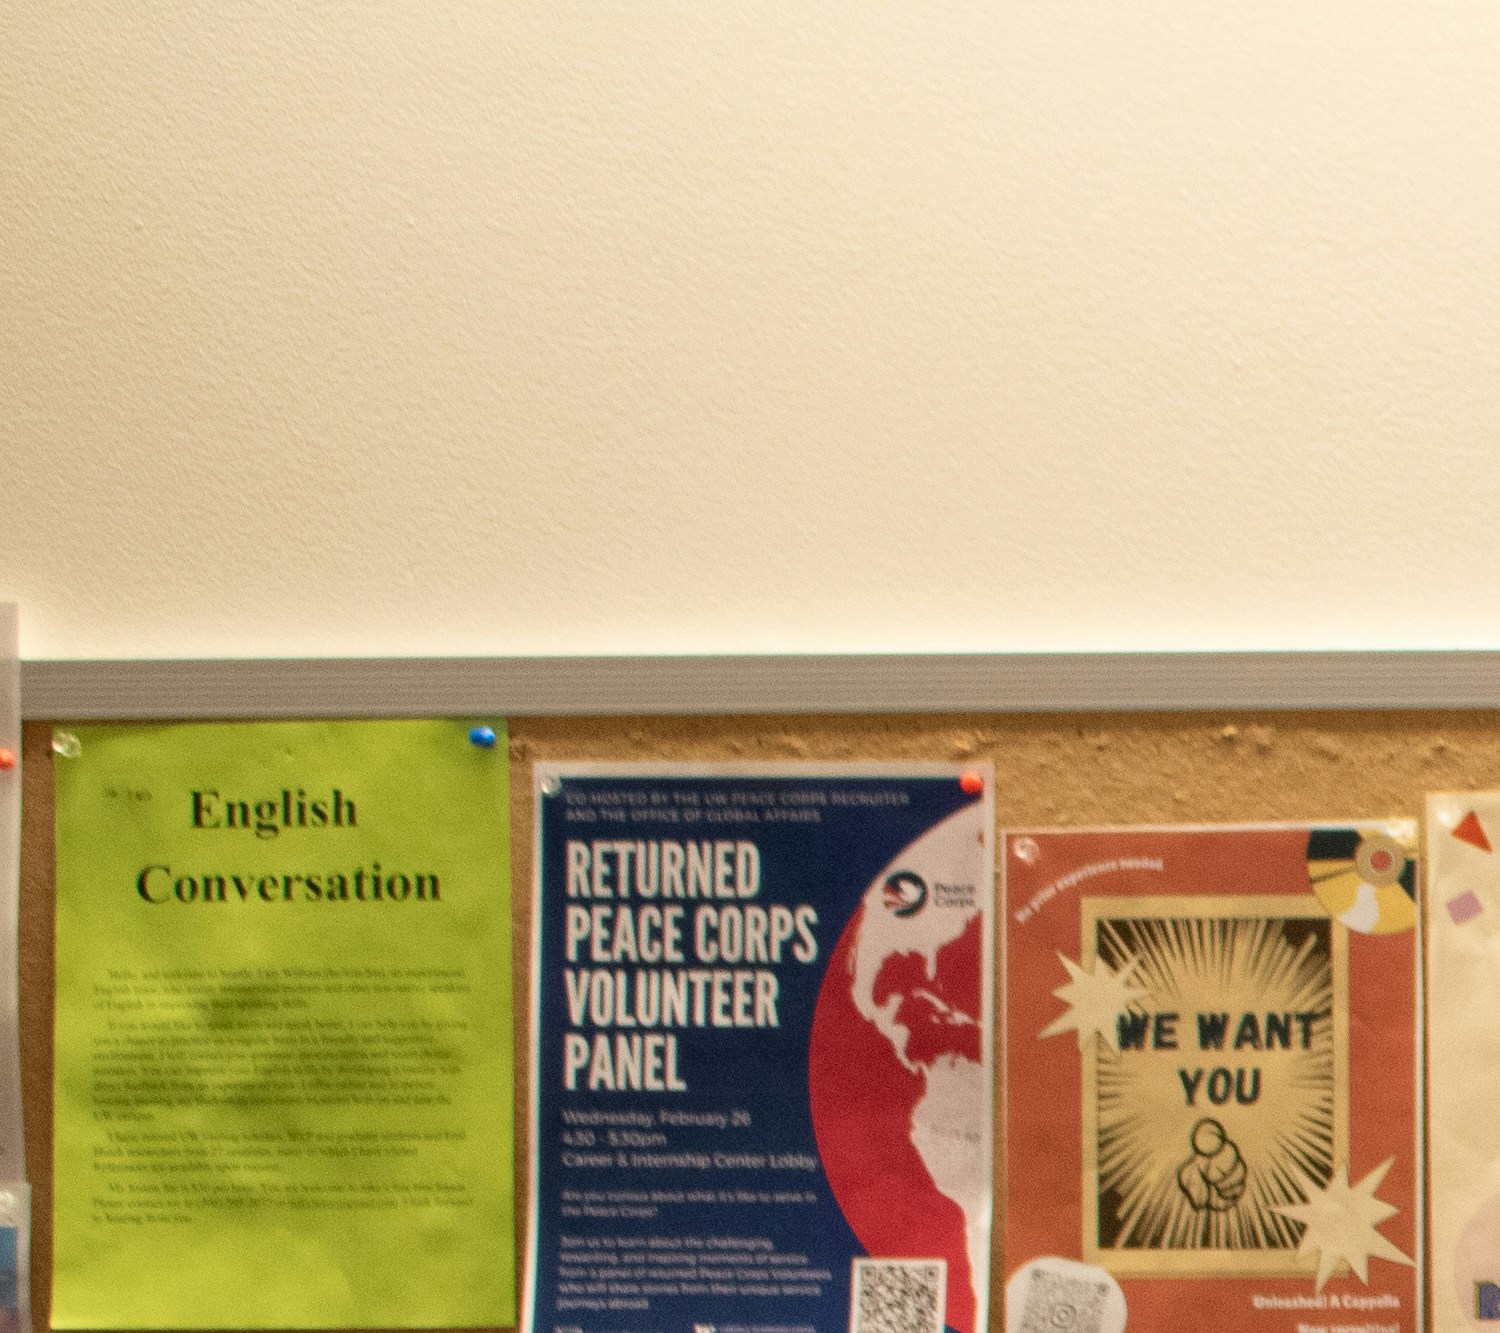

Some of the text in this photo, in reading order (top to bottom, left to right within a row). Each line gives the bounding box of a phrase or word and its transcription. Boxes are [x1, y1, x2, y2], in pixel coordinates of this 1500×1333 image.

[190, 788, 359, 839] English
[136, 864, 442, 908] Conversation
[566, 841, 760, 899] RETURNED
[565, 907, 818, 964] PEACE CORPS
[565, 971, 780, 1028] VOLUNTEER
[1117, 1011, 1320, 1052] WE WANT
[563, 1035, 686, 1091] PANEL
[1179, 1066, 1262, 1105] YOU
